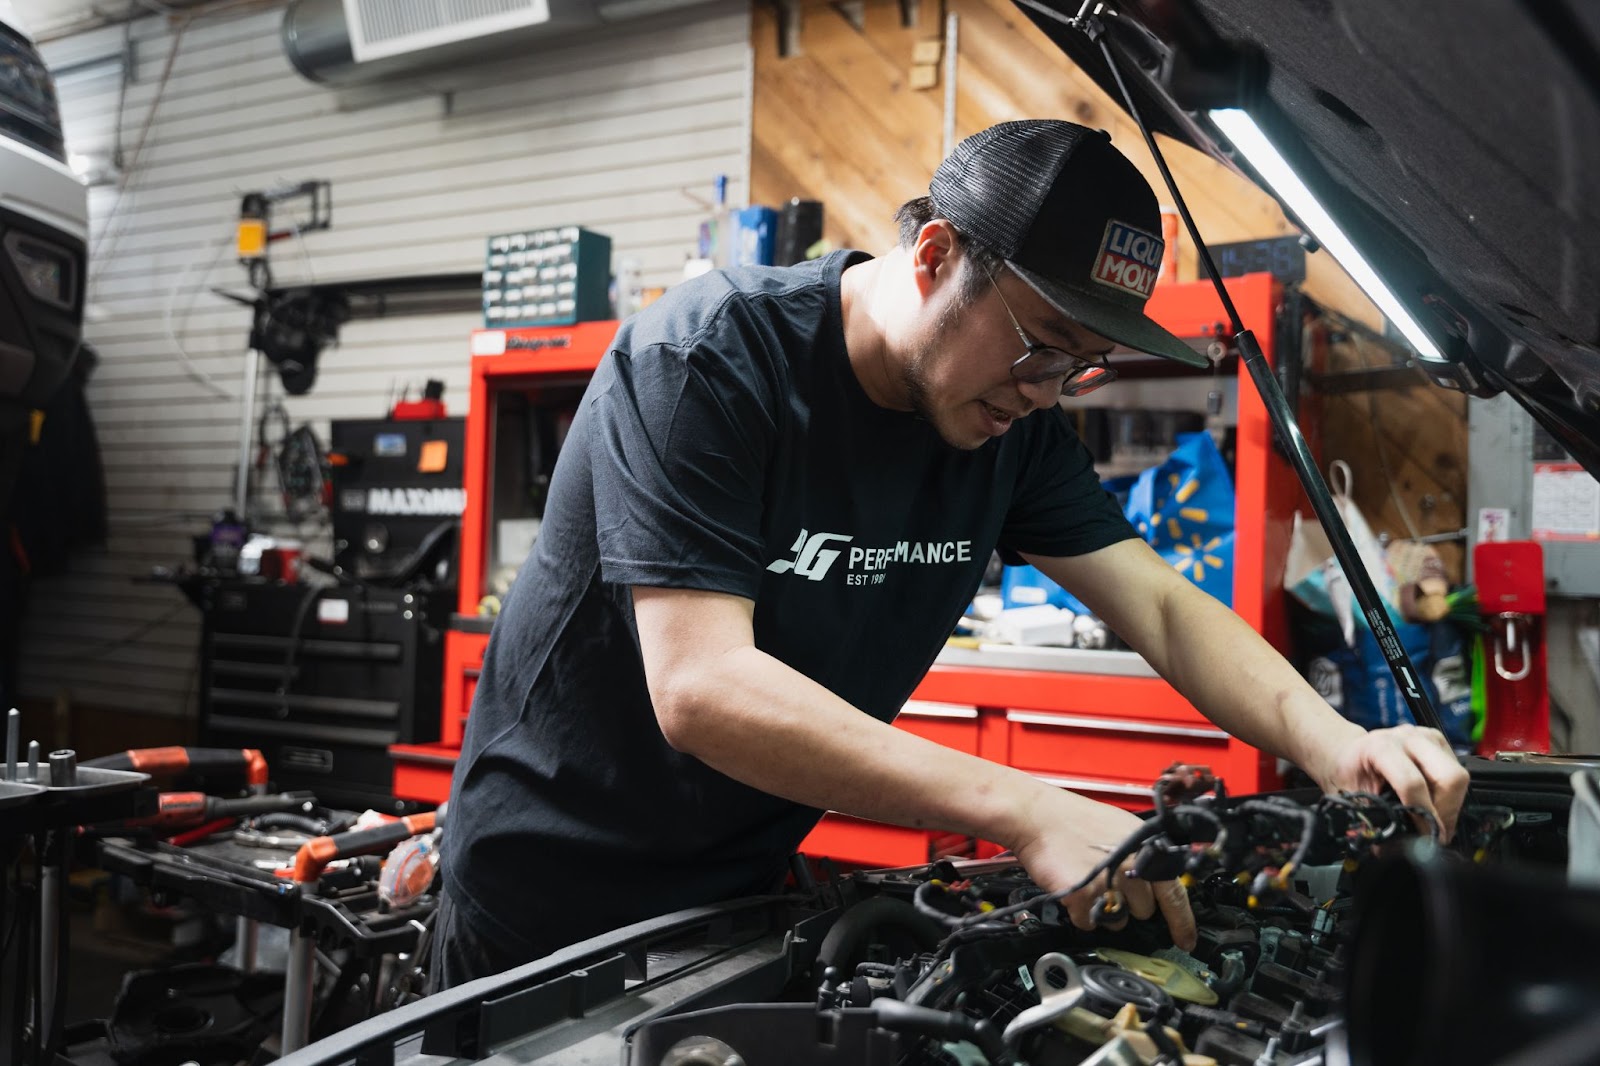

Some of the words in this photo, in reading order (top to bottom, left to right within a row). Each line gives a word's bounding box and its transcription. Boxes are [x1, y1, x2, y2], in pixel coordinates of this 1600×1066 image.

[1109, 227, 1160, 268] LIQUI
[1100, 254, 1156, 294] MOLY
[847, 574, 868, 585] EST
